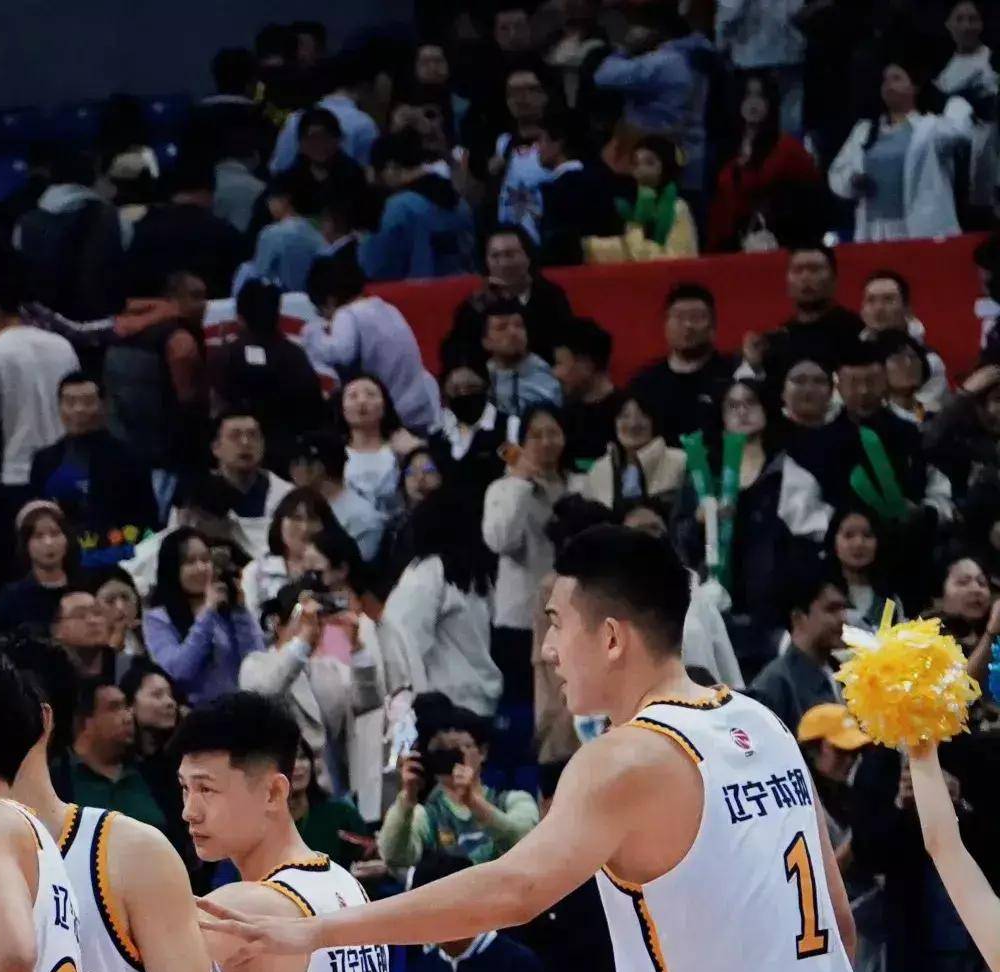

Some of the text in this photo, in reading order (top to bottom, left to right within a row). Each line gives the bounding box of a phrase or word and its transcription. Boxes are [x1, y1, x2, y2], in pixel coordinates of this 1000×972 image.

[722, 768, 812, 824] 辽宁本钢
[783, 831, 829, 960] 1
